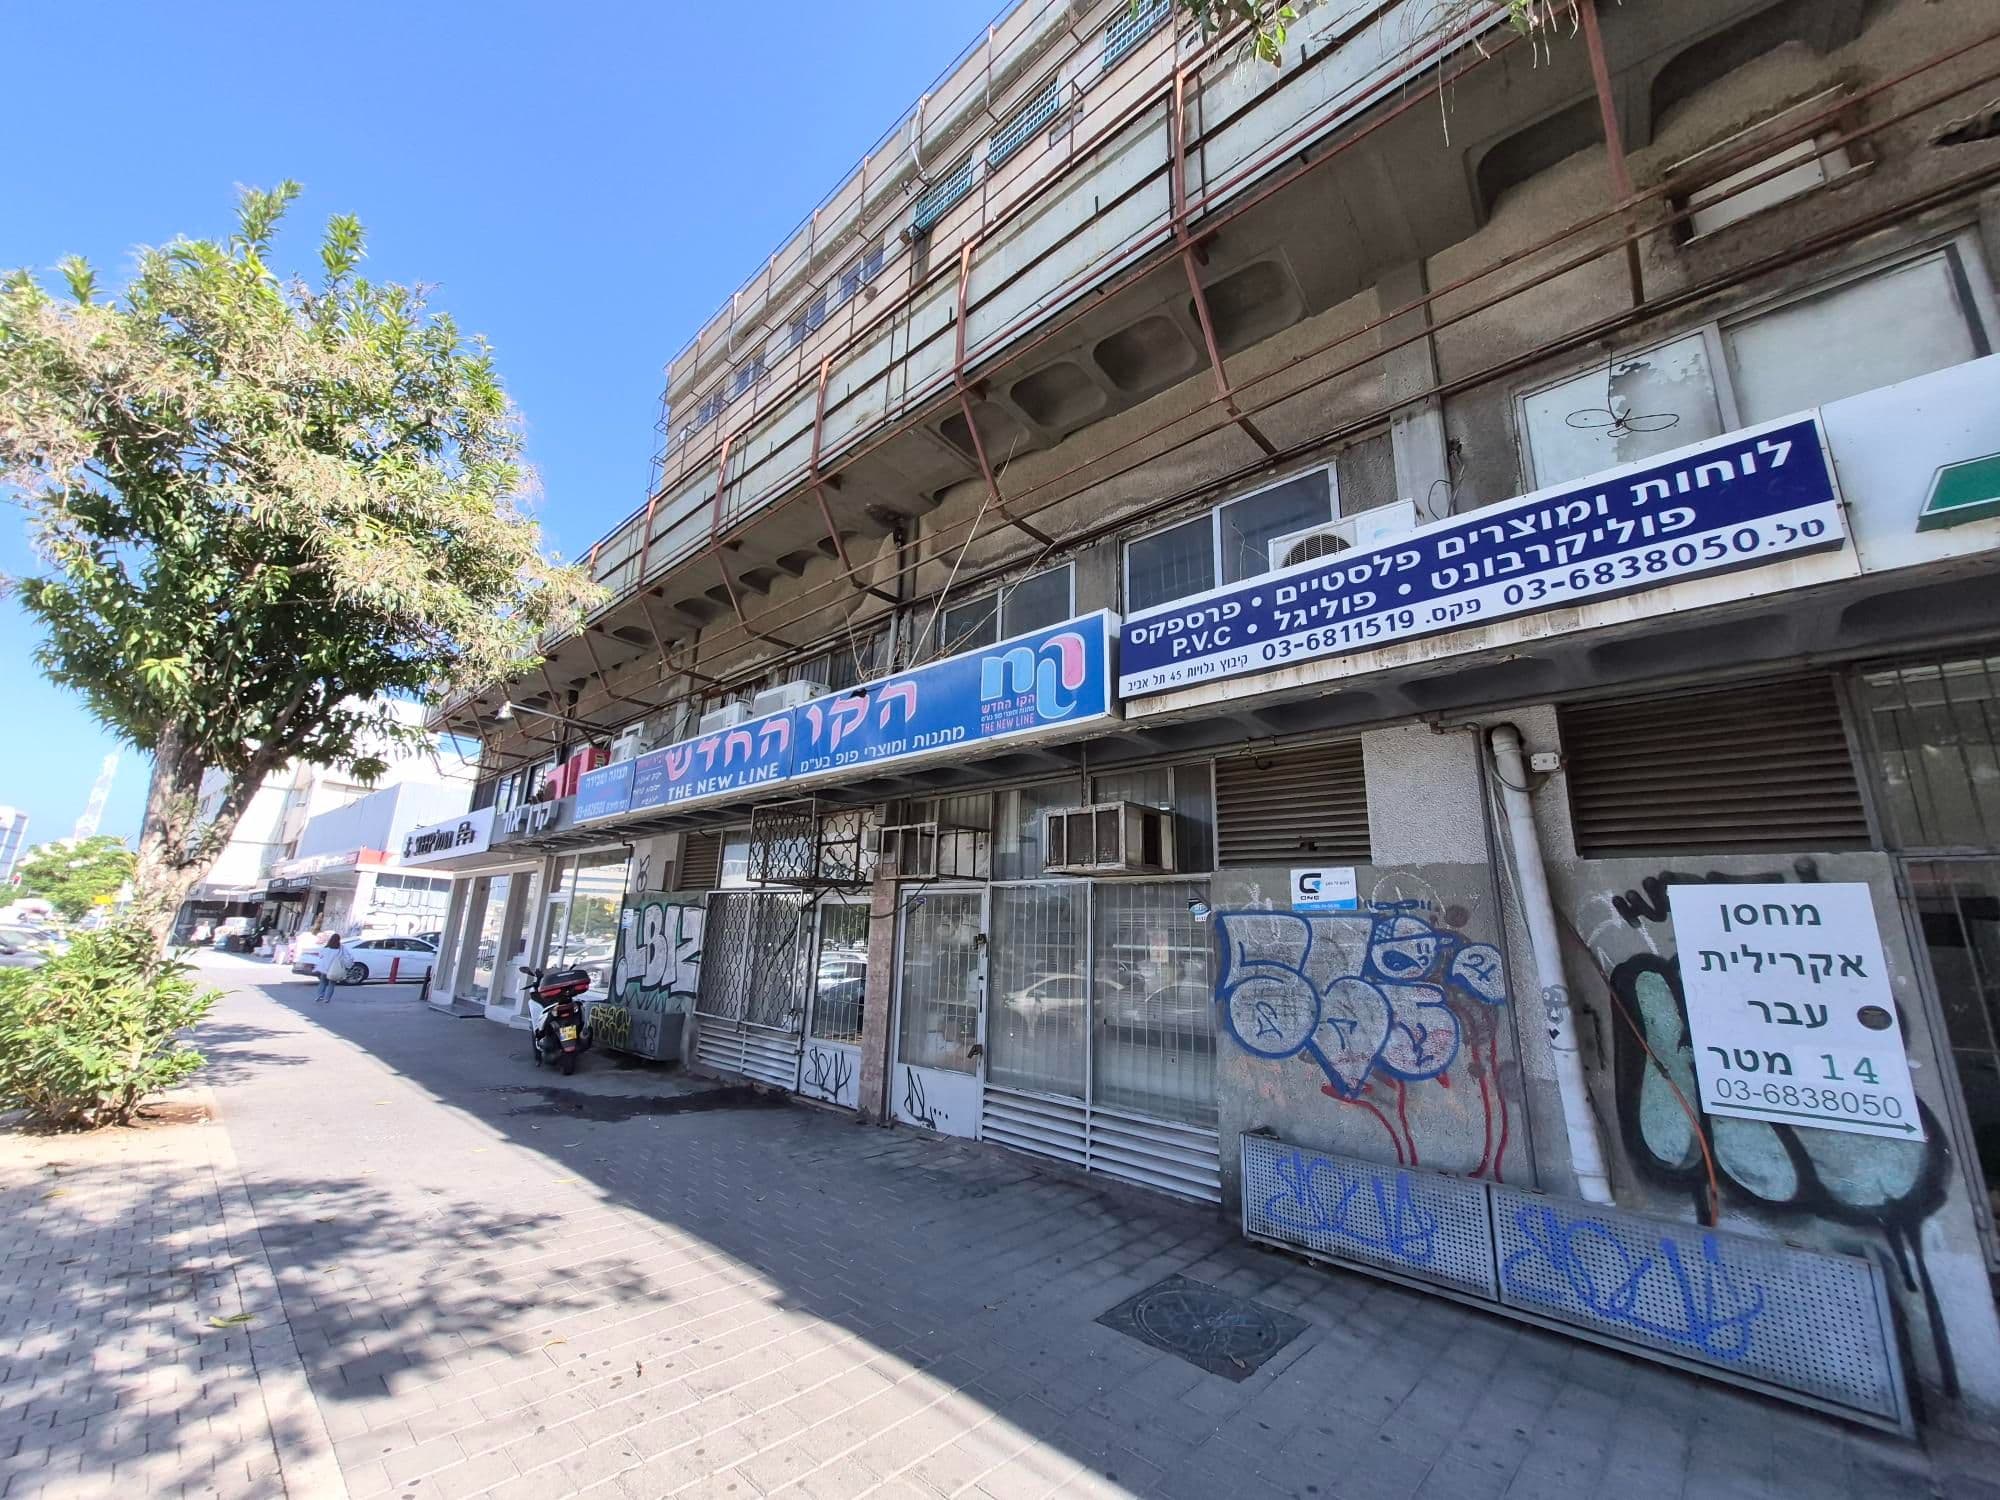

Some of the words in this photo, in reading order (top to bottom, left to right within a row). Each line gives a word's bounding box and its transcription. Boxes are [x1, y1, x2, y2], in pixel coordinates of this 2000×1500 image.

[1629, 438, 1793, 508] לוחות
[1437, 494, 1609, 560] ומוצרים
[1431, 507, 1697, 591] פוליקרבונט
[1275, 549, 1421, 606] פלסטיים
[1503, 527, 1760, 607] 03-6838050
[1130, 601, 1241, 646] פרספקס
[1274, 591, 1377, 631] פוליגל
[1172, 627, 1232, 658] P.V.C
[1262, 609, 1415, 661] 03-6811519
[1169, 671, 1182, 681] 45
[1187, 661, 1215, 678] גלויות
[1219, 654, 1248, 673] קיבוץ
[1127, 678, 1149, 693] אביב
[1153, 674, 1166, 686] תל
[805, 680, 918, 753] הקו
[996, 718, 1014, 730] NEW
[1015, 713, 1035, 726] LINE
[664, 717, 791, 782] החדש
[863, 738, 907, 758] ומוצרי
[912, 725, 965, 749] מתנות
[835, 750, 859, 766] פופ
[668, 783, 693, 801] THE
[697, 773, 733, 795] NEW
[738, 762, 779, 784] LINE
[1719, 902, 1822, 933] מחסן
[1698, 943, 1869, 984] אקרילית
[1747, 999, 1829, 1029] עבר
[1706, 1045, 1793, 1076] מטר
[1820, 1053, 1880, 1085] 14
[1715, 1078, 1903, 1119] 03-6838050
